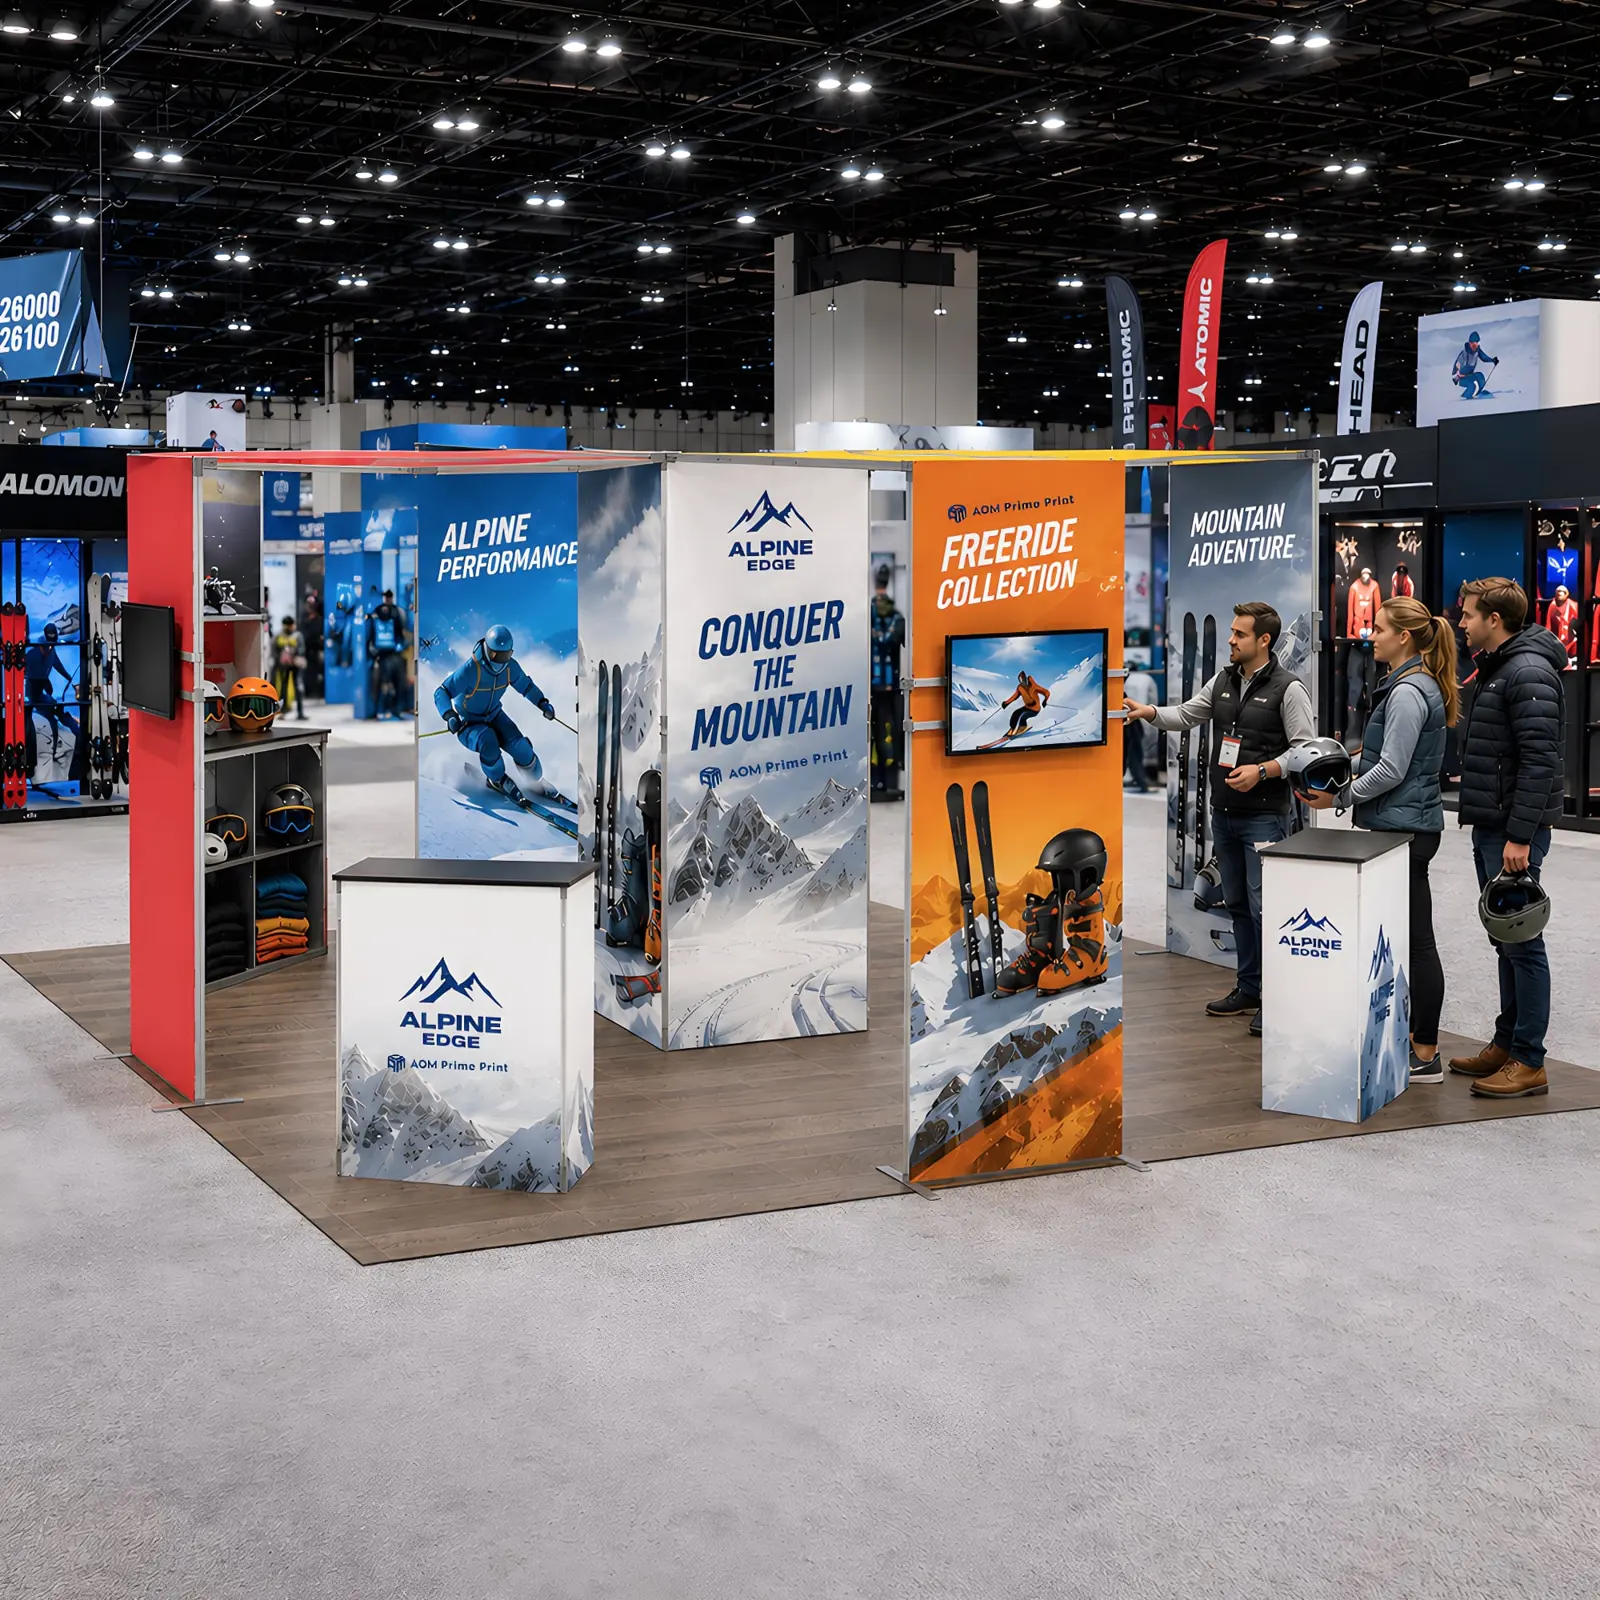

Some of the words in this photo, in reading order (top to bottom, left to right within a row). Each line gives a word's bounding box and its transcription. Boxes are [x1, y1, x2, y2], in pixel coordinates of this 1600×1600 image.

[0, 291, 61, 323] 26000
[0, 321, 60, 354] 26100
[1195, 278, 1212, 376] ATOMIC
[1348, 319, 1370, 435] HEAD
[0, 473, 125, 497] ALOMON
[972, 504, 1000, 516] AOM
[1190, 502, 1286, 538] MOUNTAIN
[440, 512, 532, 553] ALPINE
[728, 539, 814, 557] ALPINE
[940, 517, 1078, 573] FREERIDE
[437, 541, 578, 582] PERFORMANCE
[747, 559, 796, 571] EDGE
[1187, 534, 1296, 567] ADVENTURE
[936, 558, 1079, 610] COLLECTION
[698, 600, 845, 660] CONQUER
[753, 654, 797, 692] THE
[690, 684, 853, 751] MOUNTAIN
[729, 764, 761, 779] AOM
[765, 757, 808, 773] Prime
[813, 749, 849, 765] Print
[1278, 935, 1342, 950] ALPINE
[399, 1011, 502, 1034] ALPINE
[422, 1032, 480, 1049] EDGE
[410, 1059, 437, 1069] AOM
[480, 1062, 508, 1072] Print
